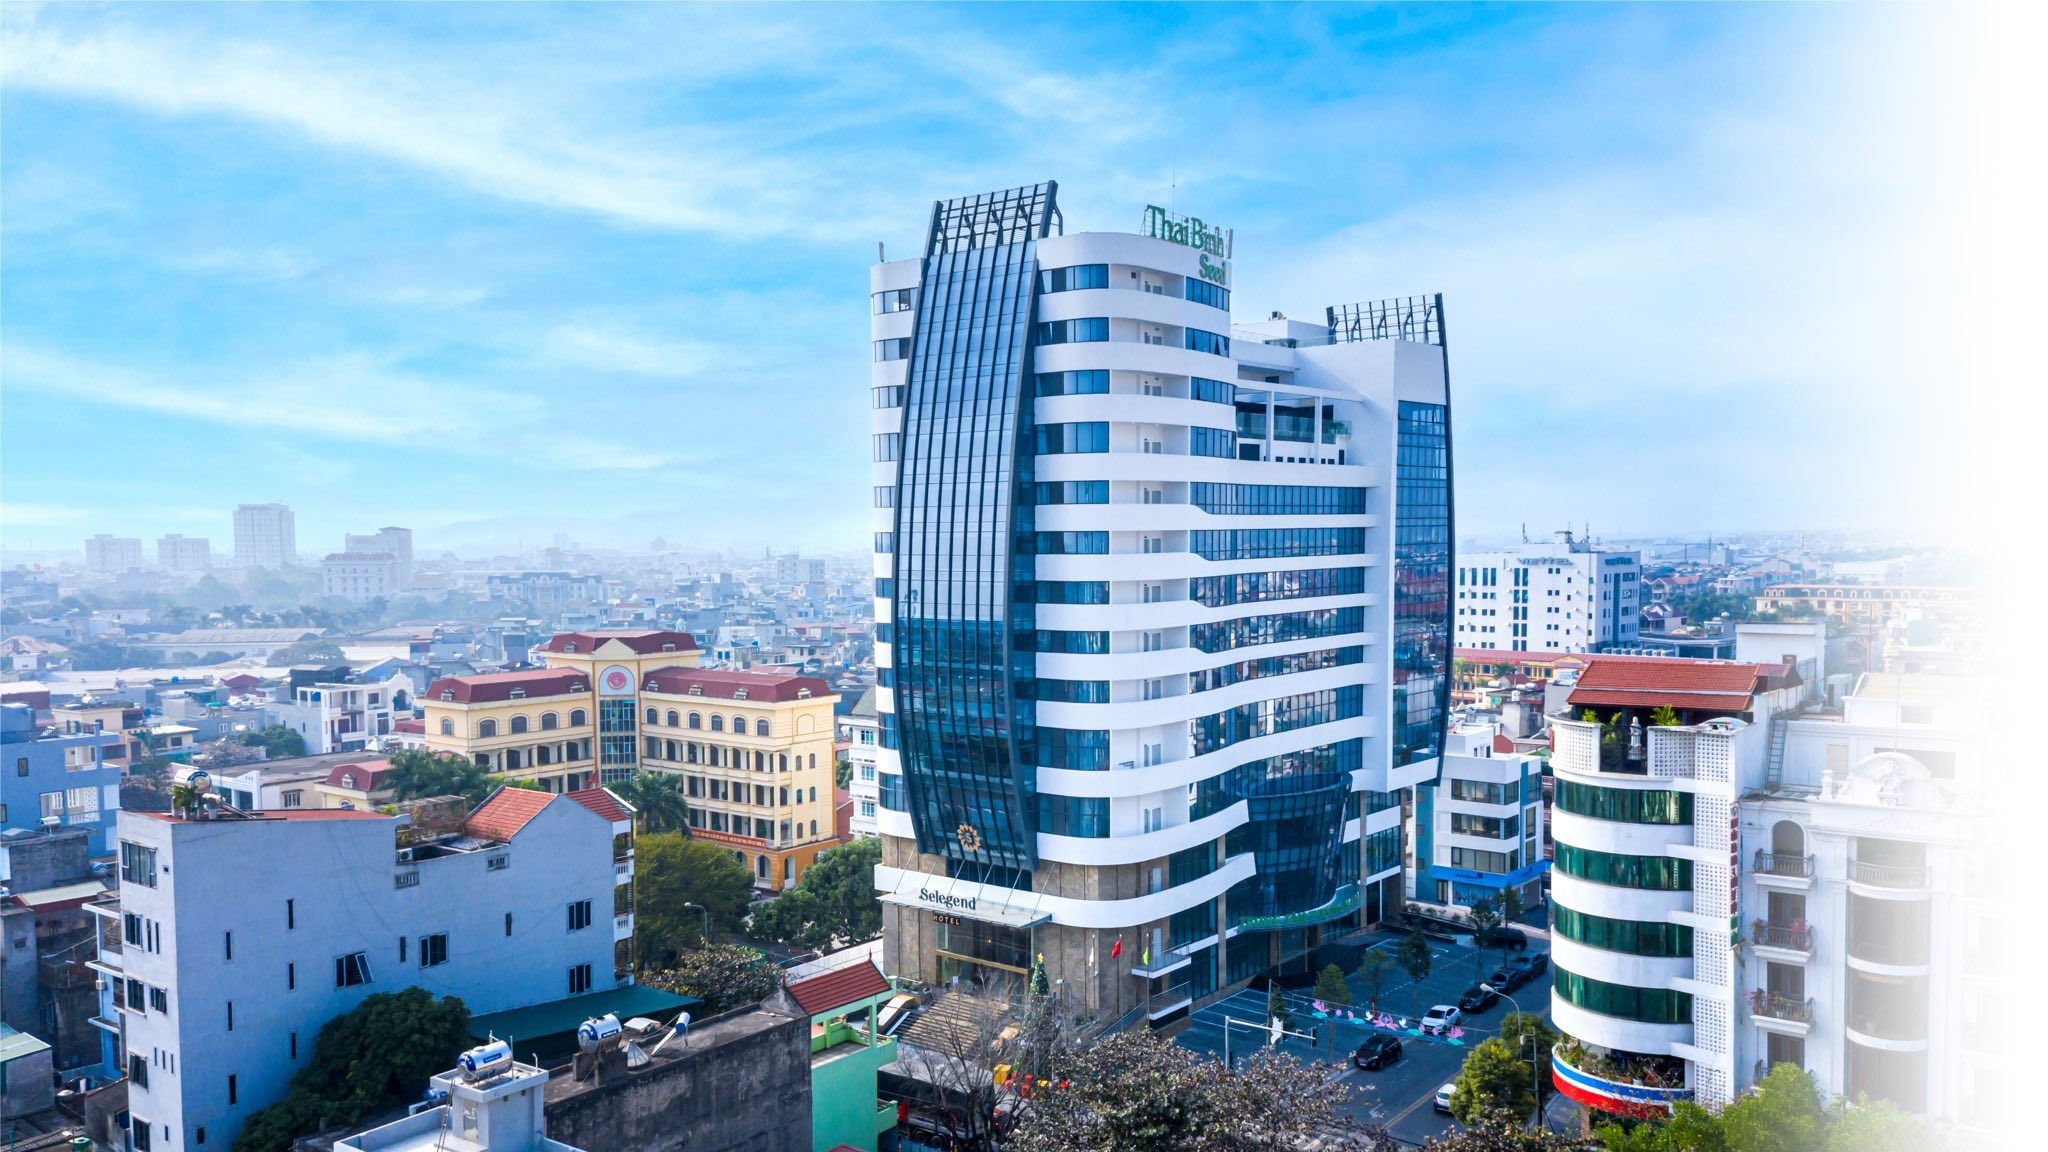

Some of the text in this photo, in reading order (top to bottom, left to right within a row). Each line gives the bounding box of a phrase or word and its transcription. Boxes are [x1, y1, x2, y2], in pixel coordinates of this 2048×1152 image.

[1199, 254, 1226, 285] Seed
[919, 888, 976, 910] Selegend
[933, 914, 960, 926] HOTEL
